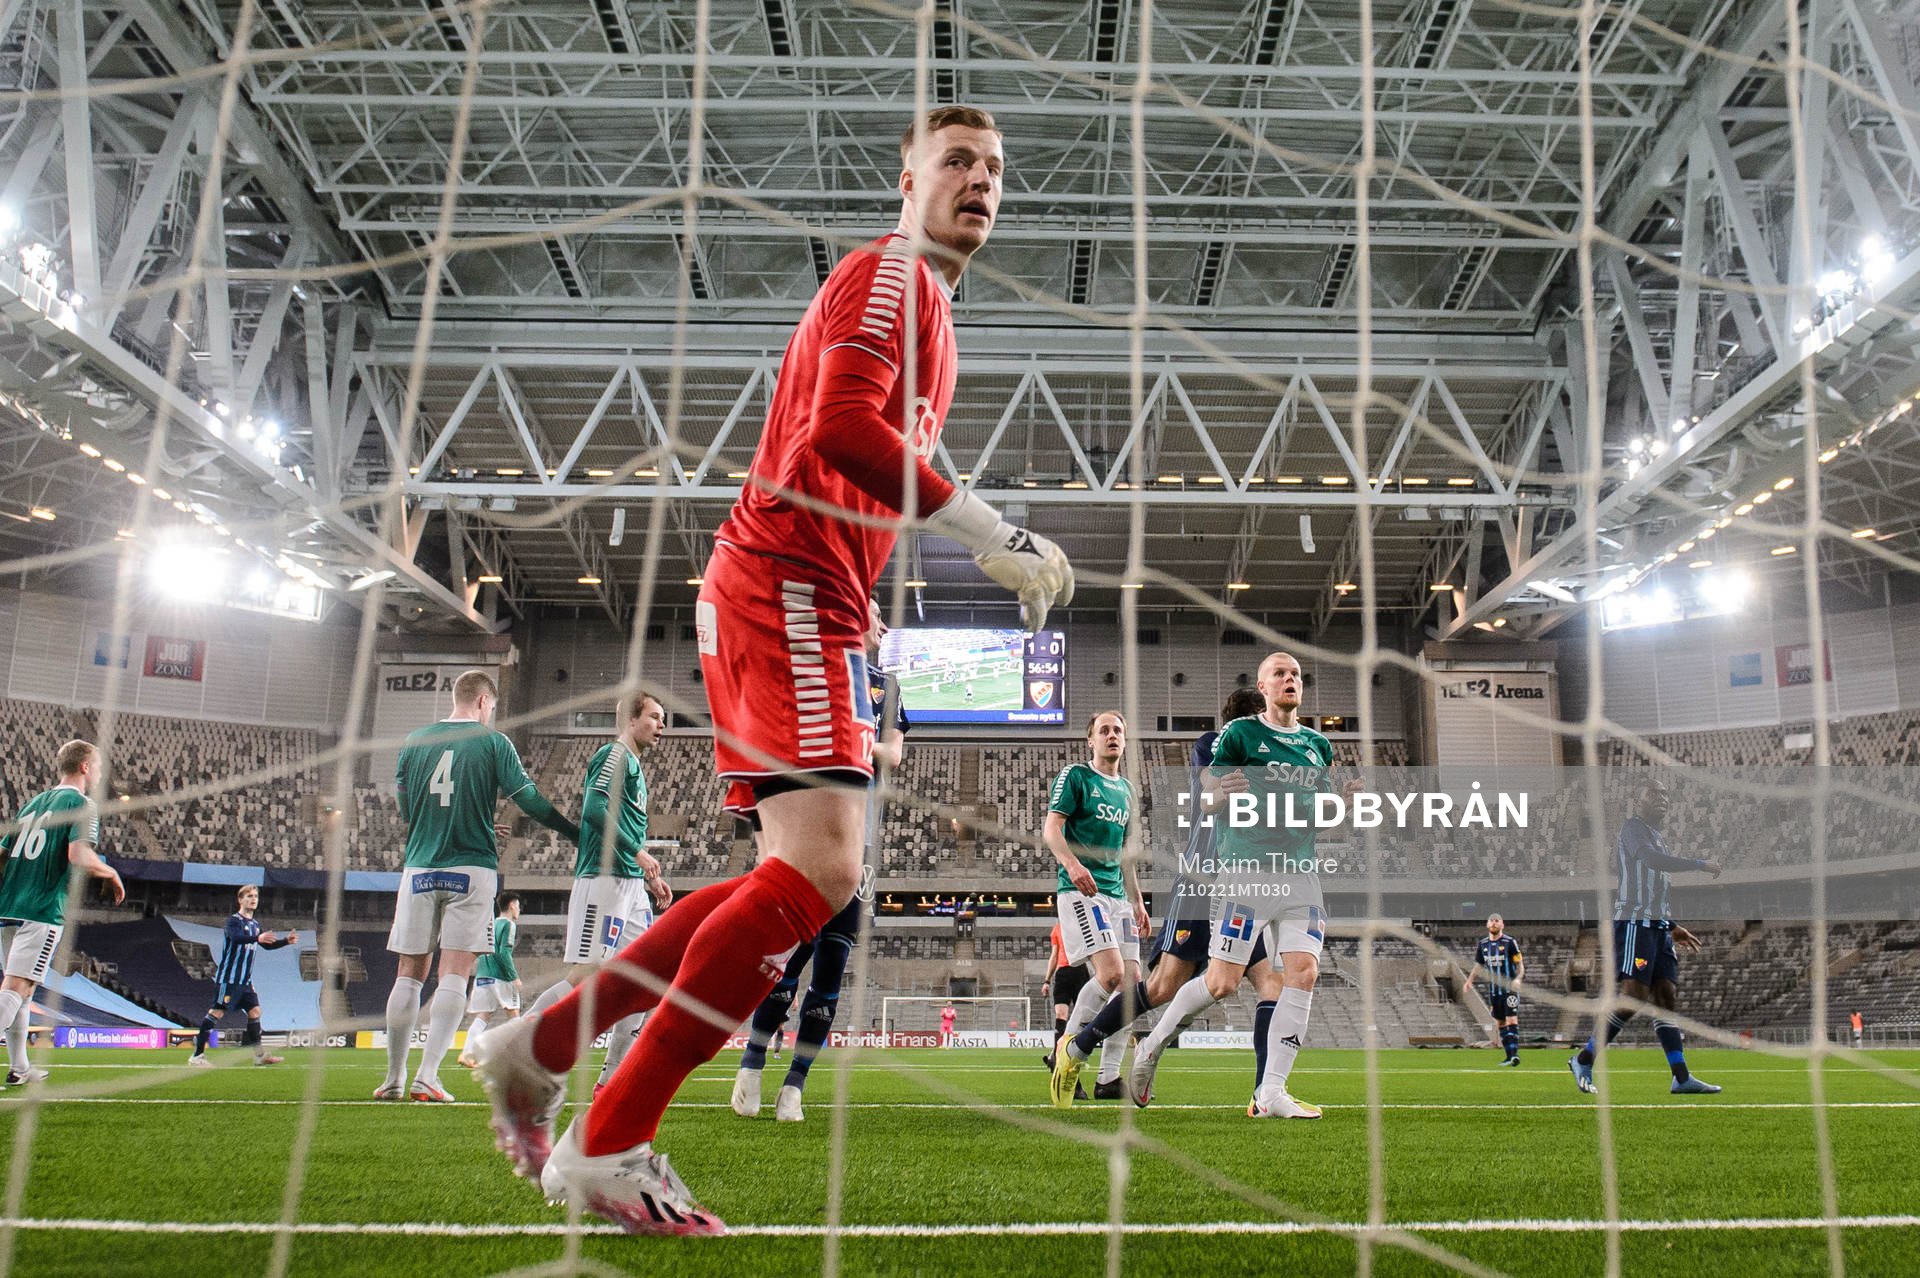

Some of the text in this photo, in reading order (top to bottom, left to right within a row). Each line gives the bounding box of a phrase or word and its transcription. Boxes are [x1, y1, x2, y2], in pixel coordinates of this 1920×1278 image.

[159, 642, 189, 662] JOB
[1028, 641, 1035, 655] 1
[1049, 641, 1060, 655] 0
[154, 663, 193, 677] ZONE
[1028, 662, 1059, 674] 56:54
[385, 671, 437, 691] TELE2
[1494, 684, 1545, 699] Arena
[429, 750, 455, 807] 4
[1264, 760, 1318, 788] SSAB
[1095, 803, 1130, 827] SSAB
[10, 810, 53, 860] 16
[1101, 932, 1112, 943] 11
[1221, 937, 1233, 953] 21
[289, 1028, 347, 1047] adidas
[831, 1032, 937, 1047] Prioritet Finans
[953, 1038, 988, 1048] RASTA
